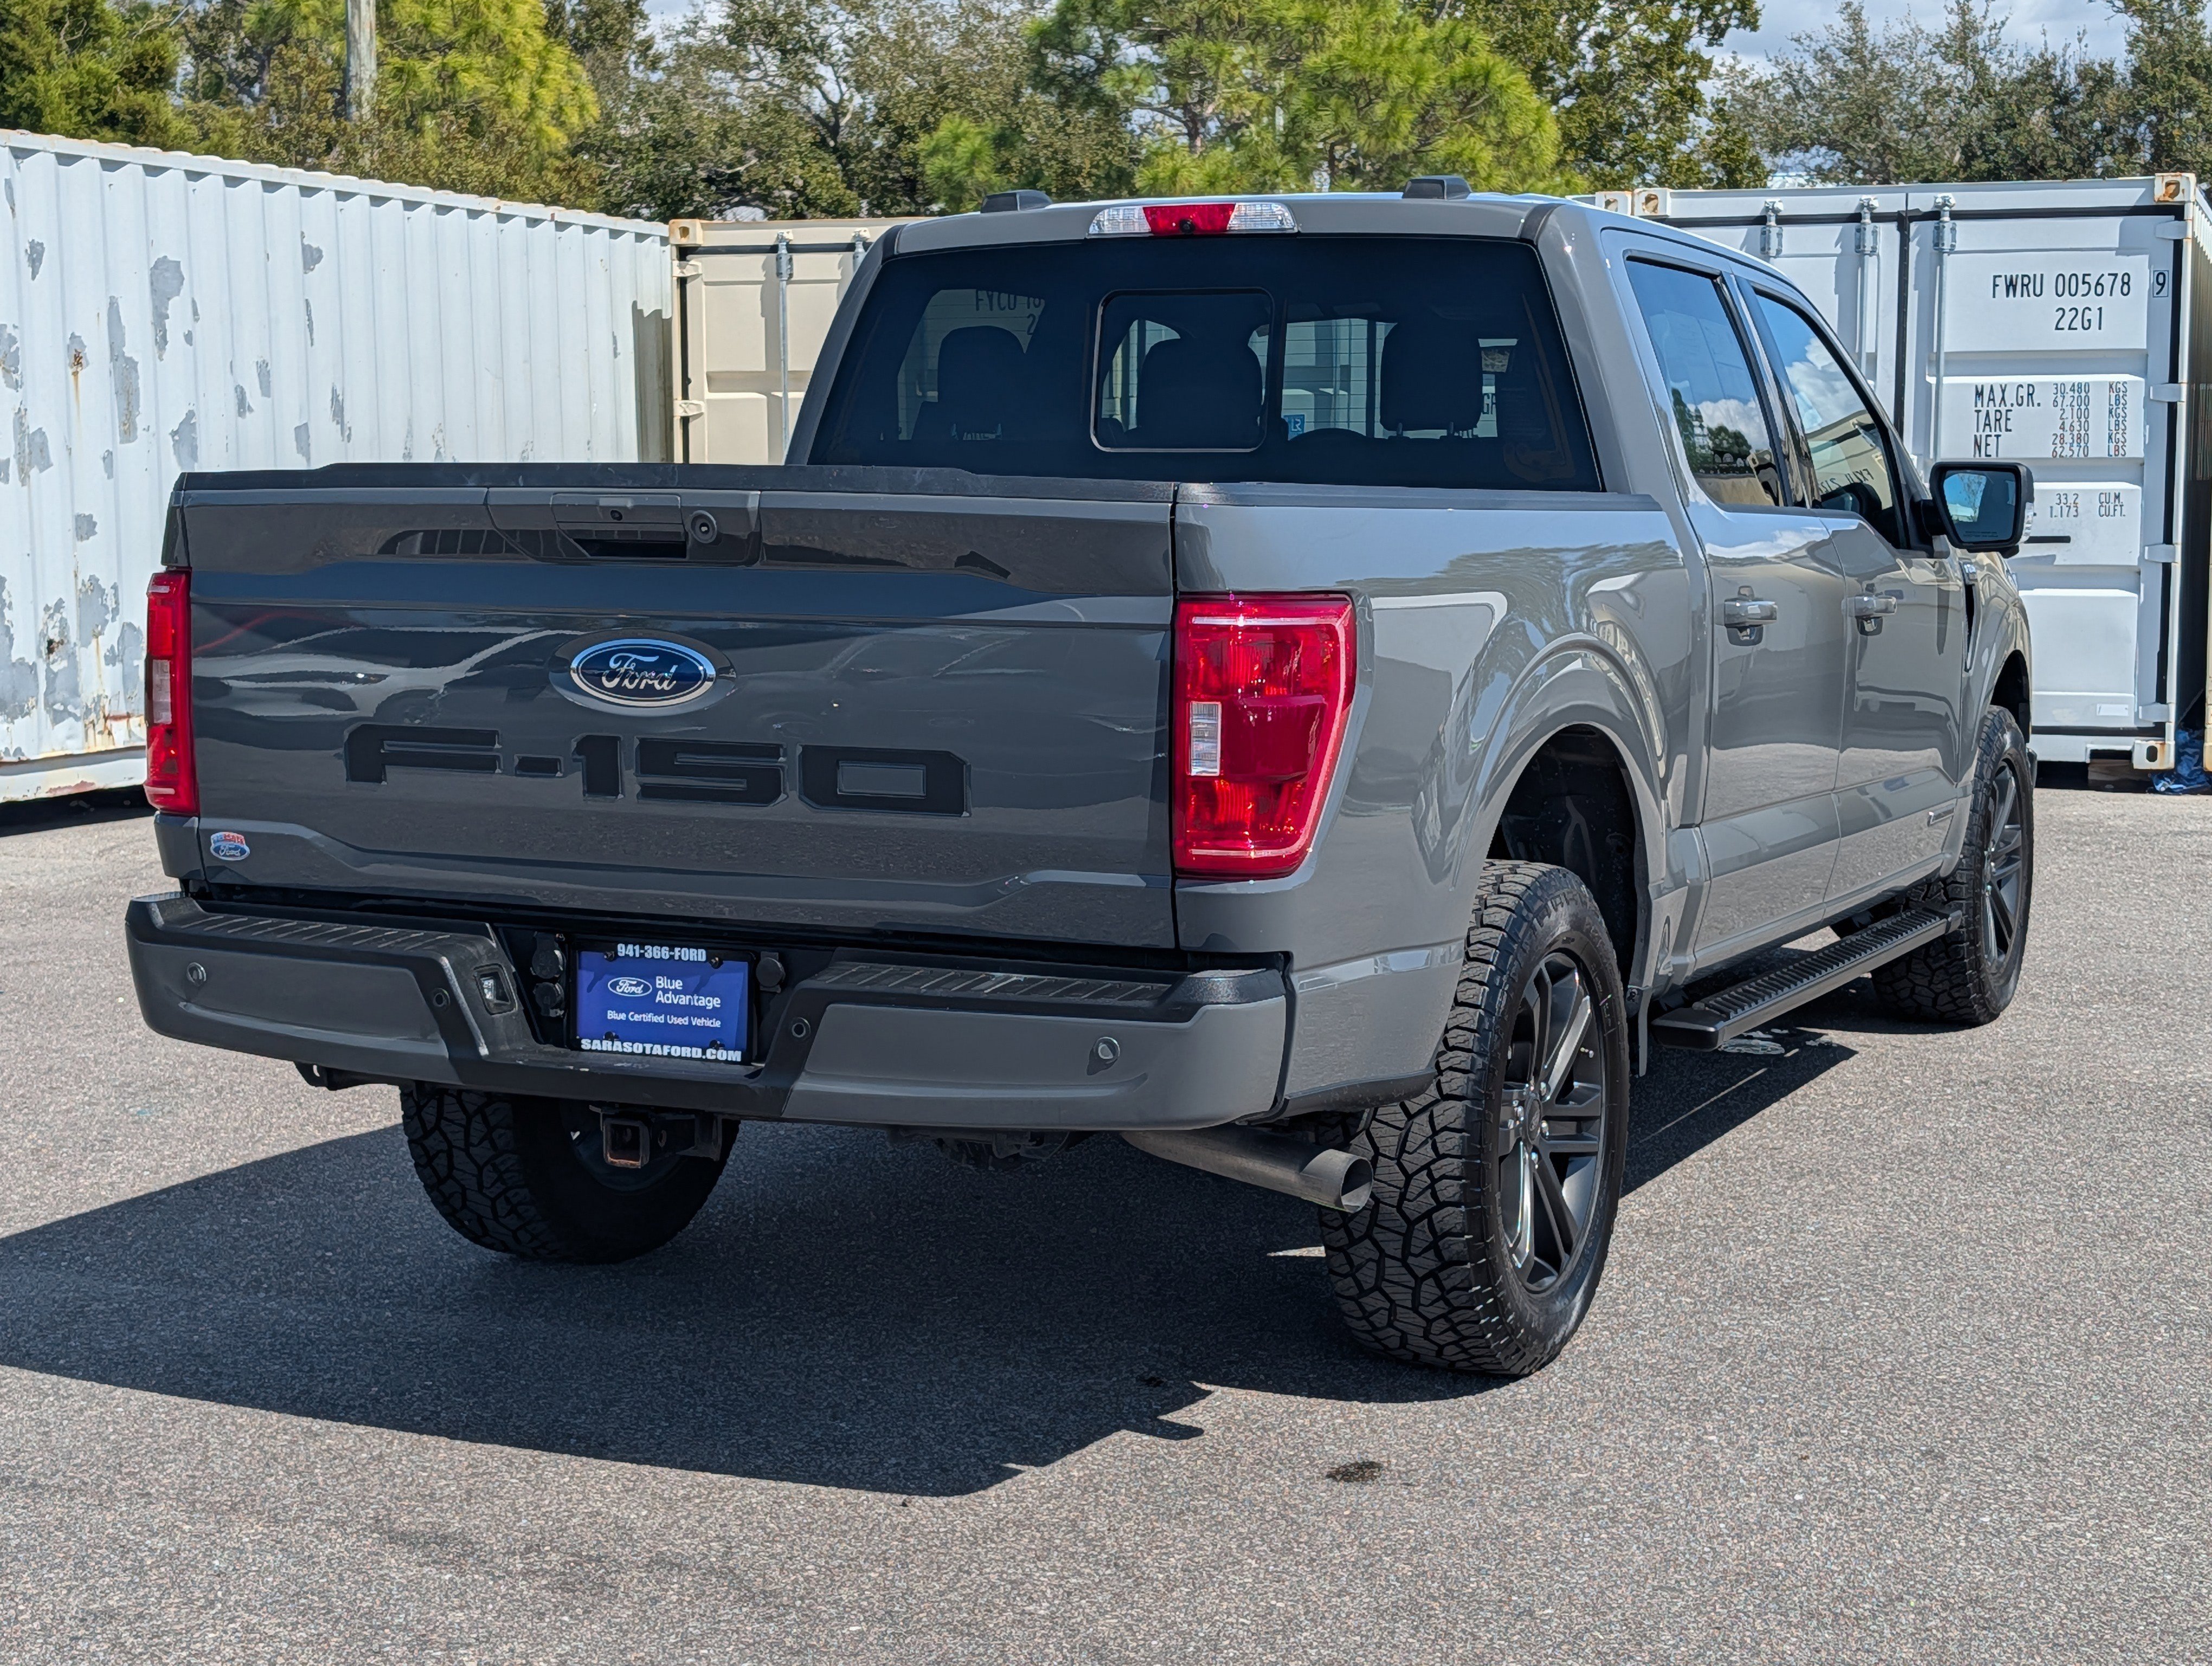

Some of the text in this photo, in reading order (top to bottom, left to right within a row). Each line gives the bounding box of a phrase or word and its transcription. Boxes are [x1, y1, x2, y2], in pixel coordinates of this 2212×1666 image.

[1992, 272, 2166, 298] FWRU 005678 9
[2054, 306, 2104, 331] 22G1
[1974, 381, 2127, 407] MAX.GR. 30.480 KGS
[2053, 394, 2127, 407] 67.200 LBS
[1974, 407, 2127, 433] TARE 2.100 KGS
[2059, 420, 2127, 432] 4.630 LBS
[1973, 432, 2127, 458] NET 28.380 KGS
[2052, 445, 2126, 458] 62.570 LBS
[2055, 492, 2079, 505] 33.2
[2050, 505, 2079, 518] 1.173
[600, 651, 680, 693] Ford
[344, 723, 972, 817] F-150
[617, 943, 707, 962] 941-366-FORD
[616, 979, 644, 995] Ford
[655, 976, 683, 990] Blue
[655, 990, 721, 1009] Advantage
[607, 1010, 721, 1028] Blue Certified Used Vehicle
[580, 1039, 742, 1062] SARASOTAFORD.COM
